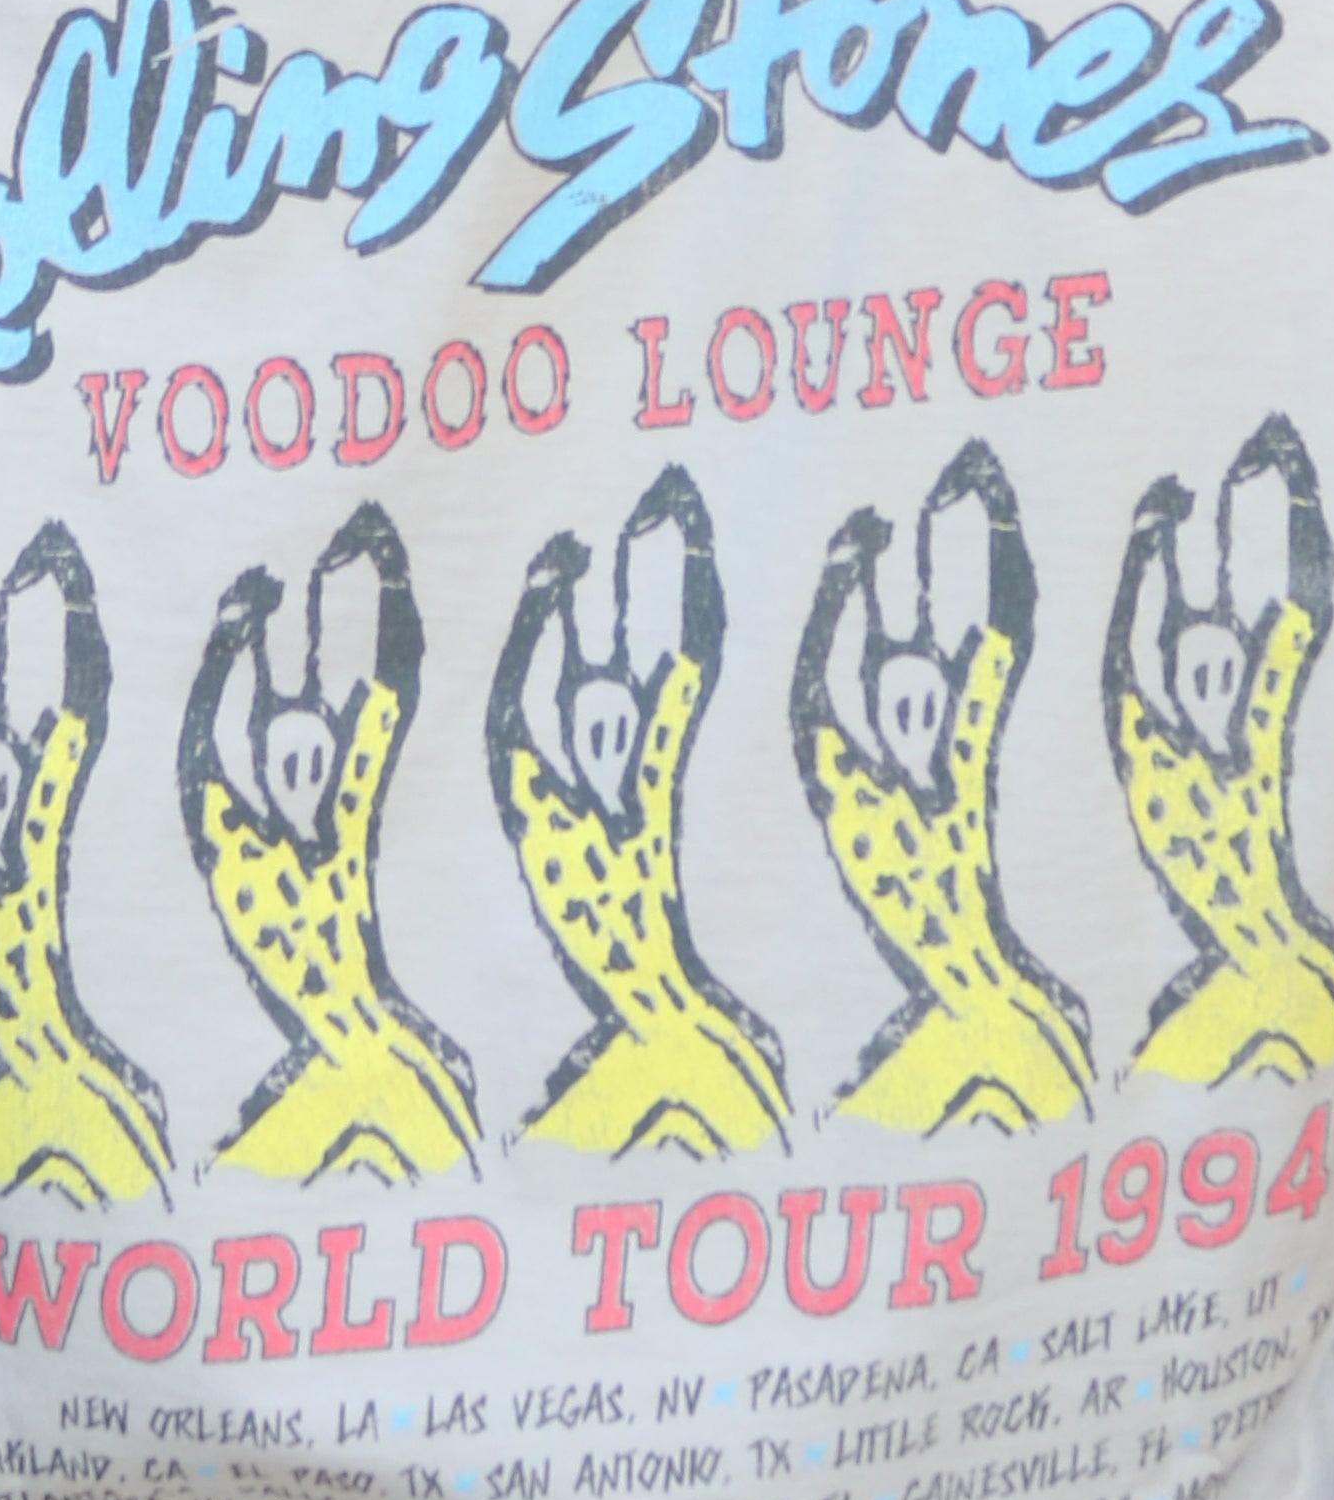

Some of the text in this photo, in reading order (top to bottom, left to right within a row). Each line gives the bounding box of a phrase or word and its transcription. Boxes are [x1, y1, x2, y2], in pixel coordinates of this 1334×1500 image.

[74, 270, 1113, 485] VOODOO LOUNGE
[571, 1178, 988, 1334] TOUR
[1038, 1100, 1333, 1283] 1994
[60, 1396, 129, 1436] NEW
[149, 1404, 315, 1449] ORLEANS,
[337, 1399, 379, 1445] LA
[425, 1392, 487, 1438] LAS
[512, 1380, 636, 1430] VEGAS,
[657, 1374, 706, 1423] NV
[956, 1334, 1000, 1382] CA
[1039, 1310, 1115, 1365] SALT
[1245, 1271, 1281, 1318] UT
[399, 1463, 444, 1500] TX
[747, 1437, 793, 1480] TX
[833, 1410, 939, 1469] LITTLE
[1079, 1374, 1129, 1419] AR
[1138, 1424, 1173, 1468] FL
